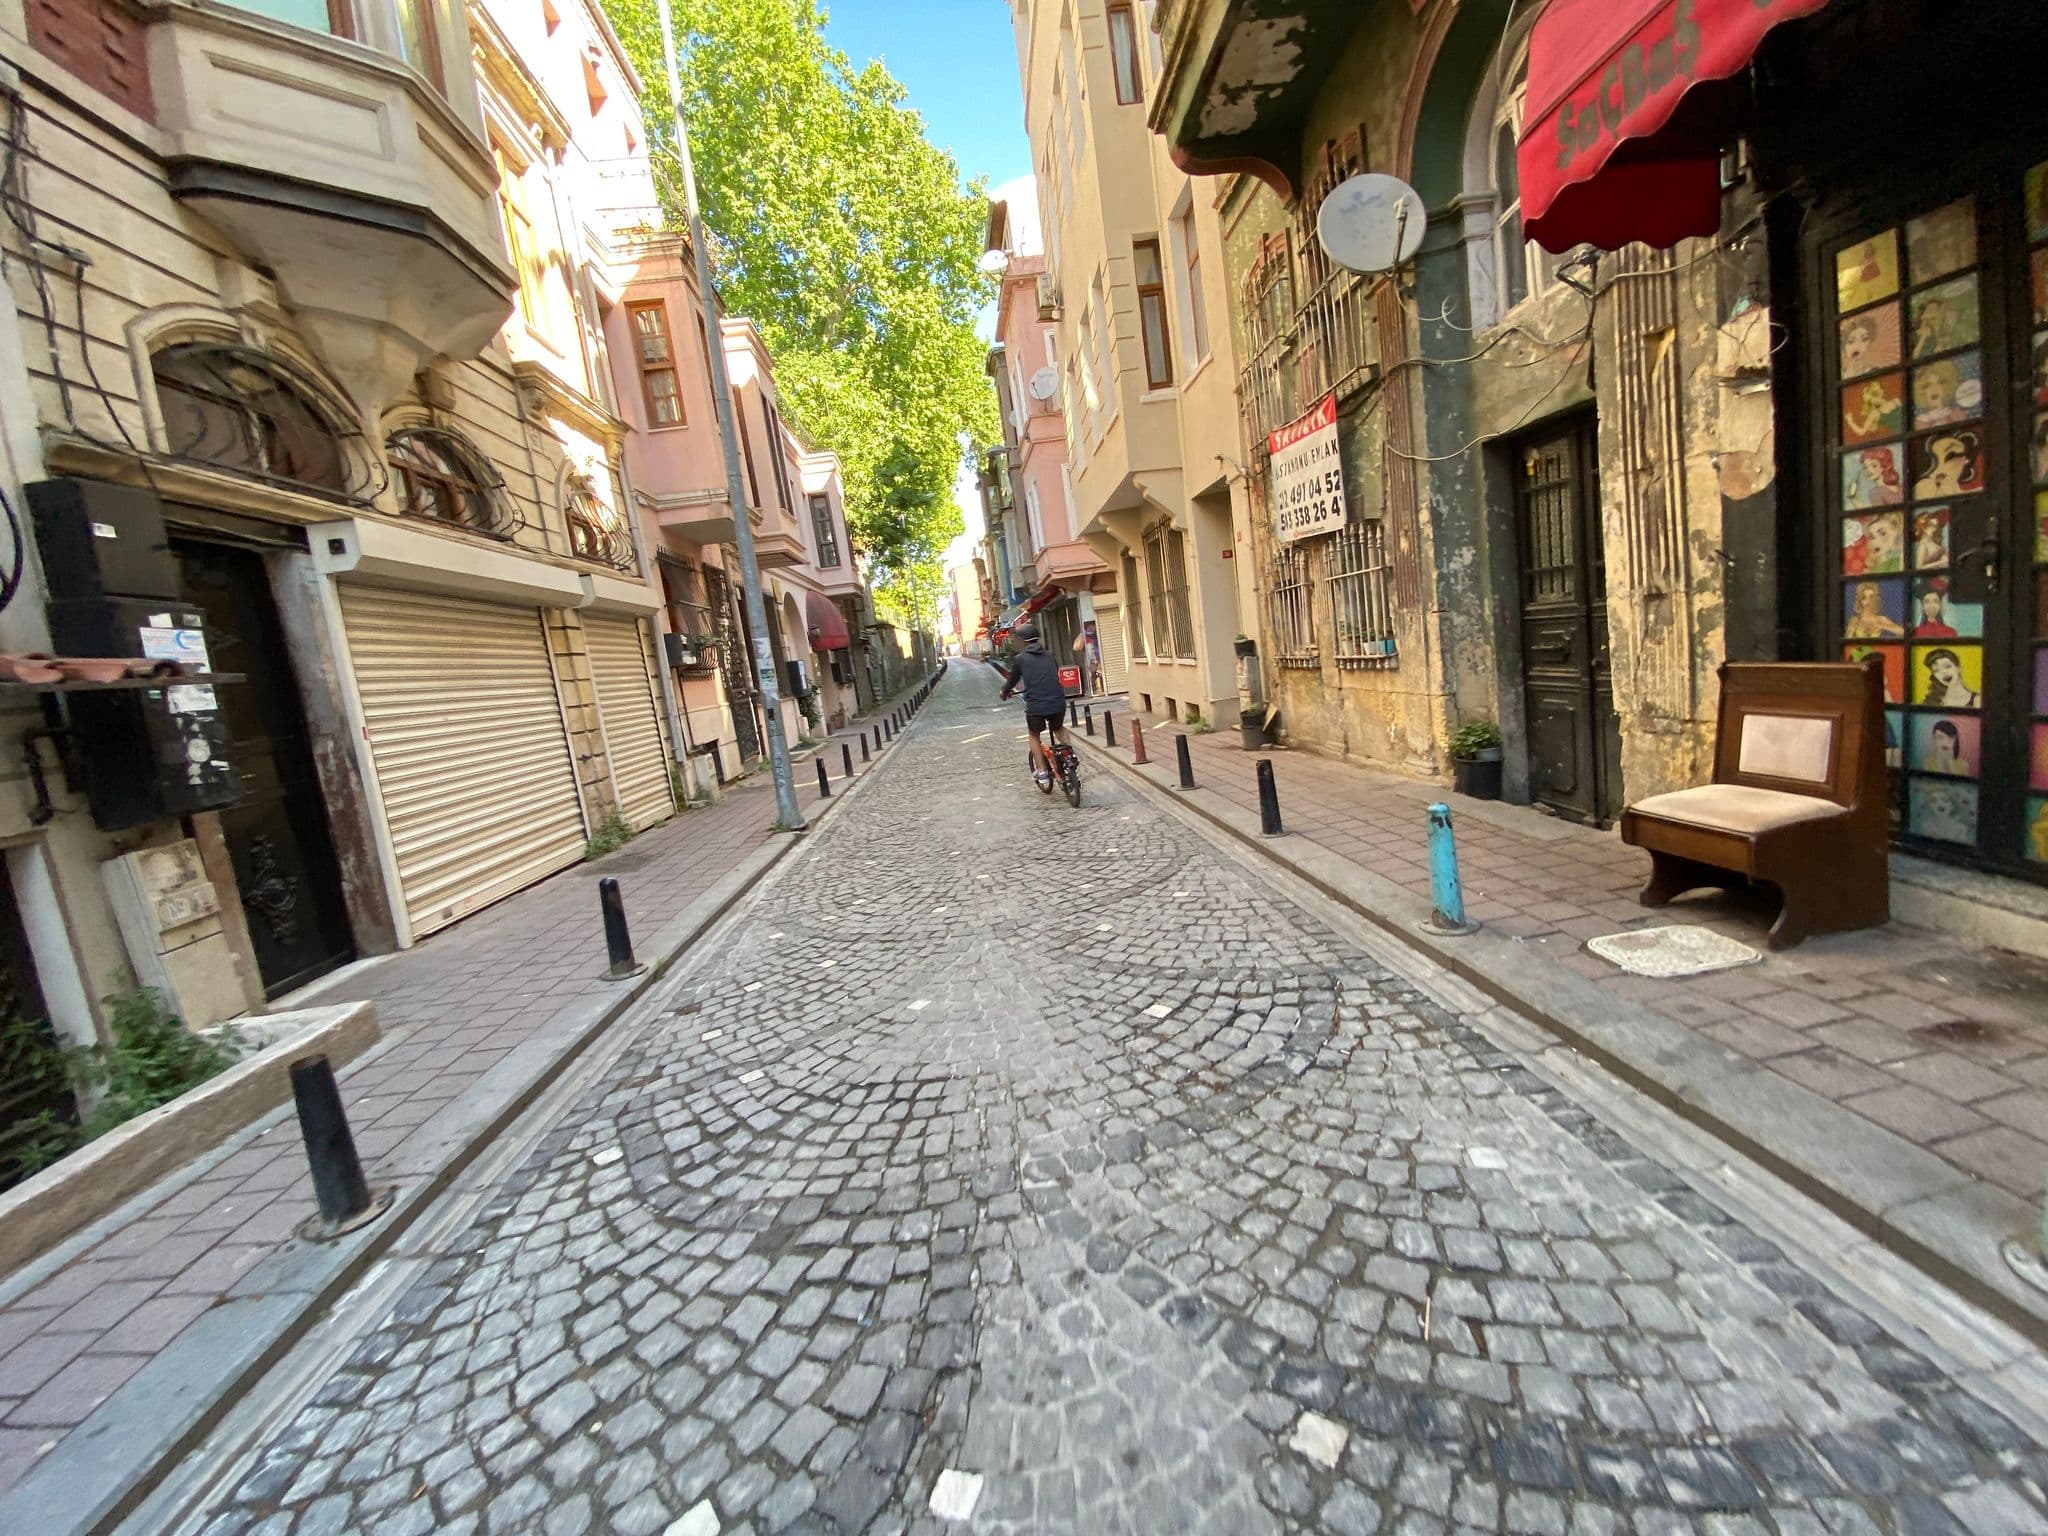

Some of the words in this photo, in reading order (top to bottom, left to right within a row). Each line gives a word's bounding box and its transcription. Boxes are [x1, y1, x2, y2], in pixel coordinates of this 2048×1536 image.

[1290, 483, 1306, 505] 491
[1309, 476, 1322, 499] 04
[1325, 469, 1341, 493] 52
[1294, 505, 1311, 528] 338
[1313, 500, 1327, 522] 26
[1331, 496, 1342, 516] 4
